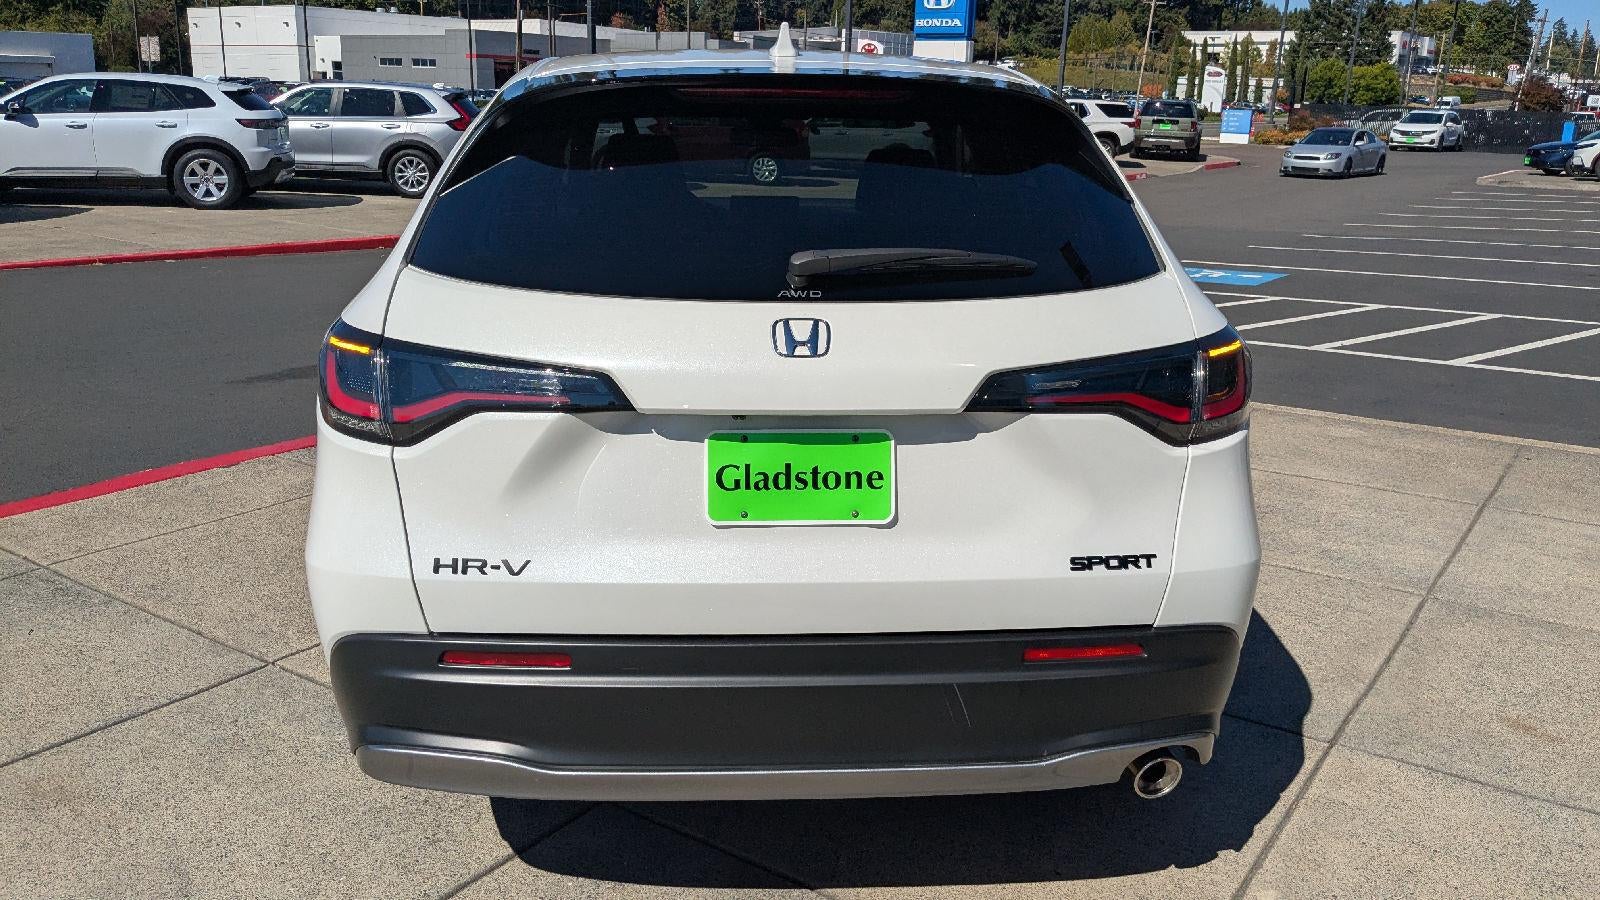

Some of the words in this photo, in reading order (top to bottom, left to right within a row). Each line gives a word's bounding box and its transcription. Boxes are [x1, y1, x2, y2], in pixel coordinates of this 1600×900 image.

[915, 18, 962, 27] HONDA
[777, 290, 822, 298] AWD
[715, 462, 884, 491] Gladstone
[433, 557, 531, 576] HR-V
[1070, 554, 1157, 571] SPORT
